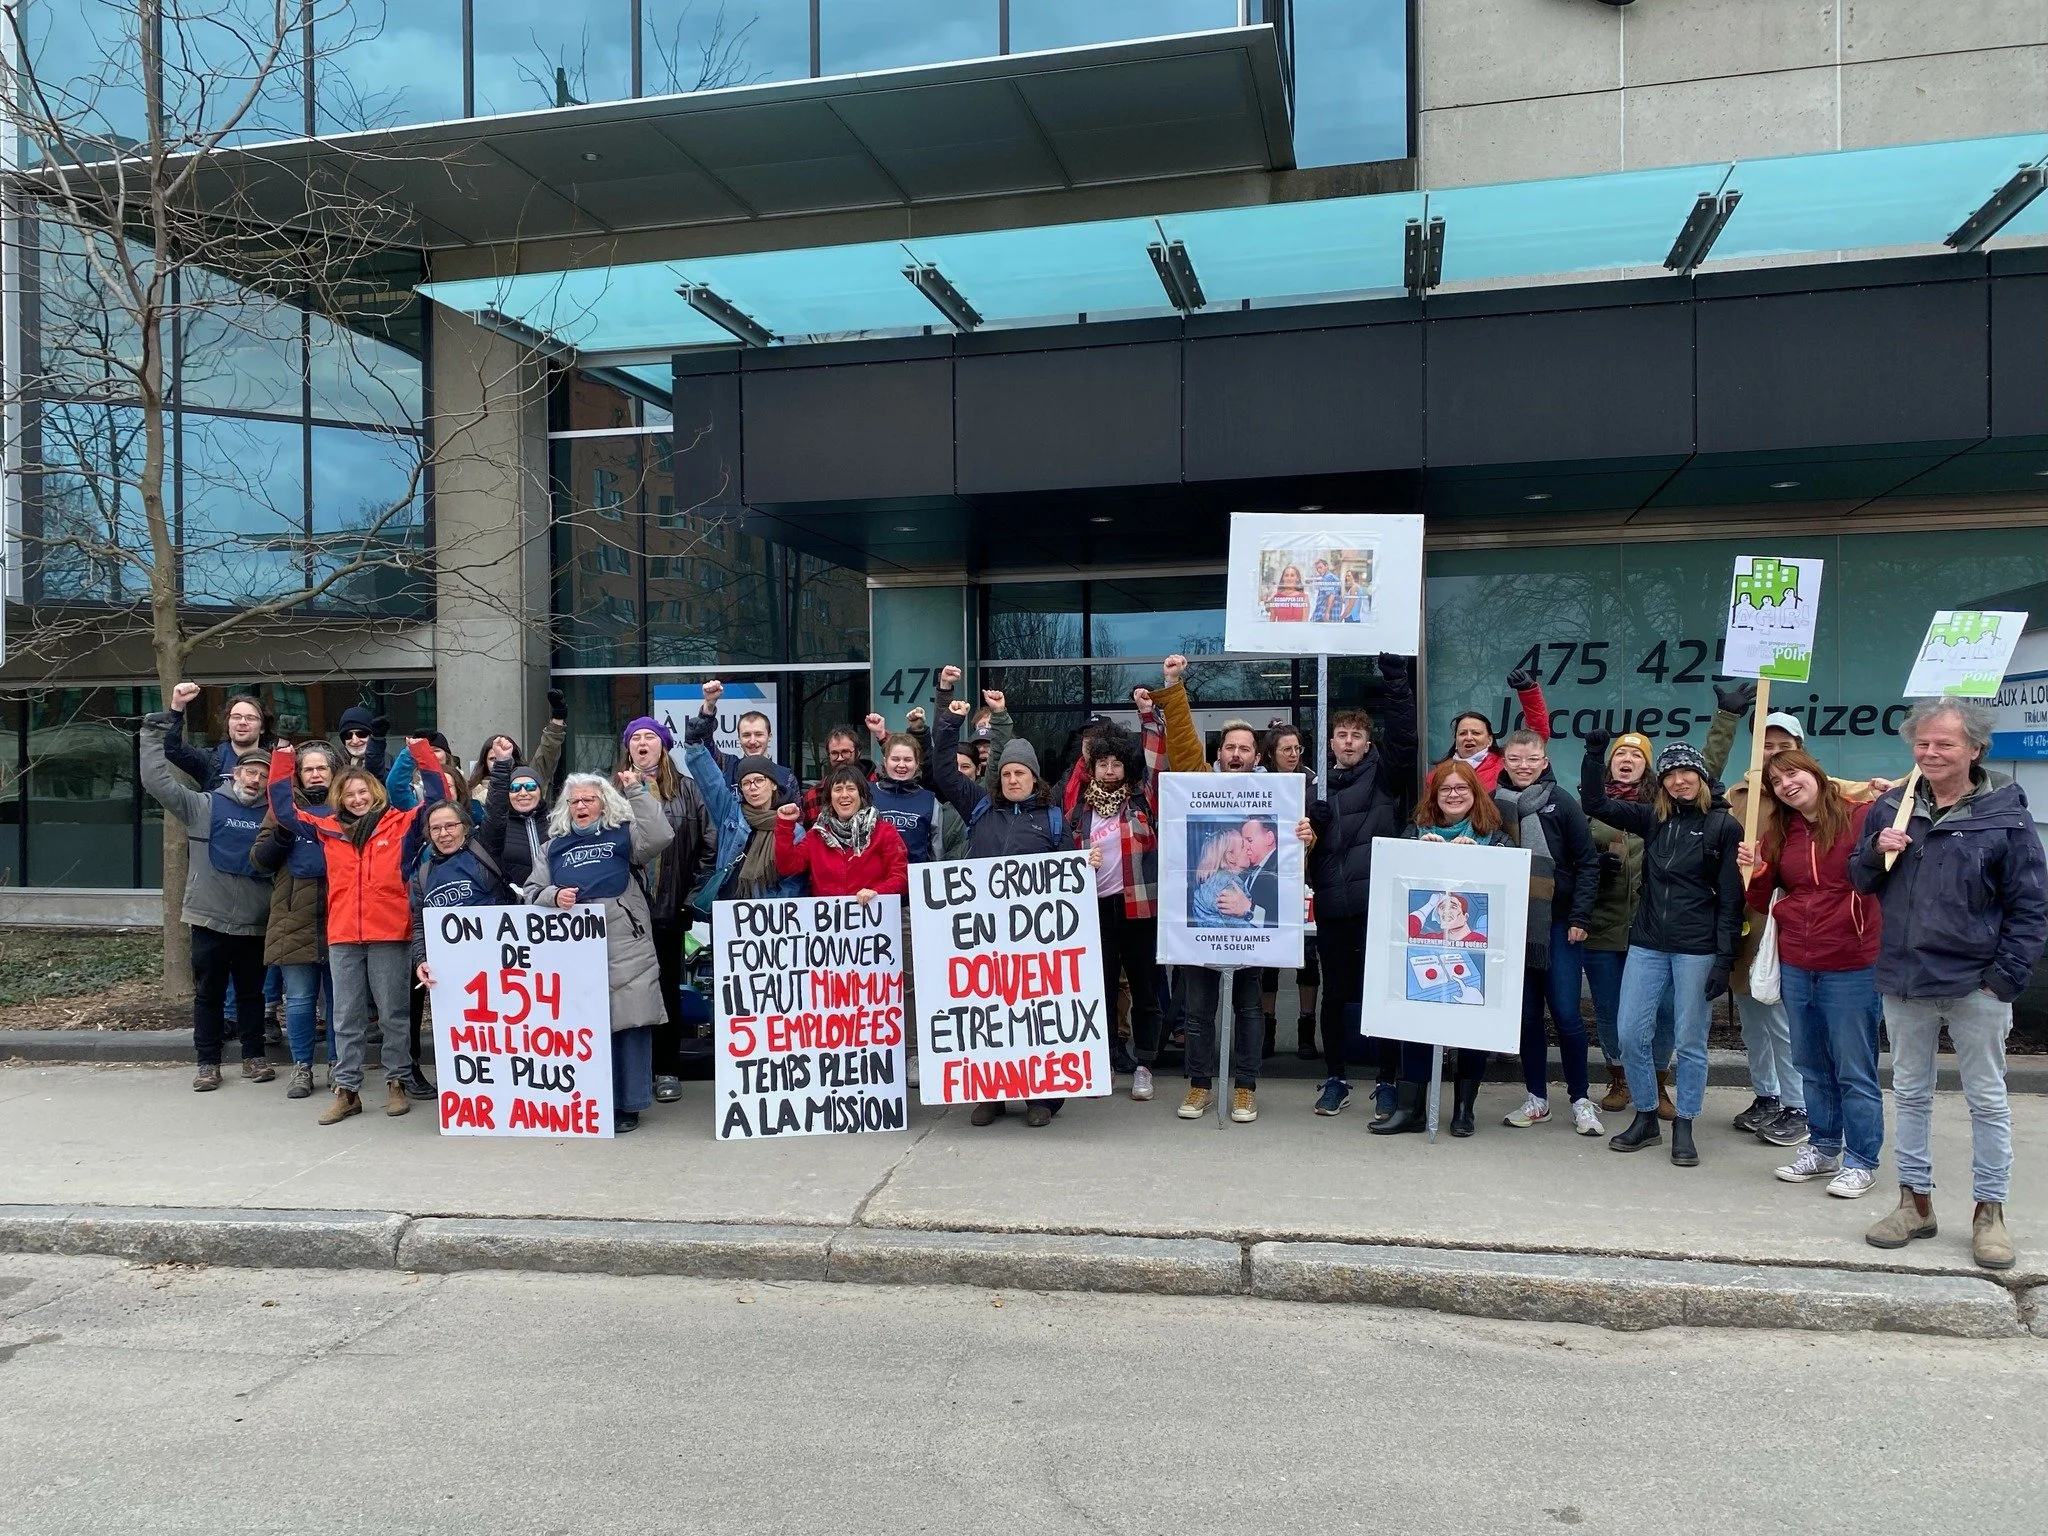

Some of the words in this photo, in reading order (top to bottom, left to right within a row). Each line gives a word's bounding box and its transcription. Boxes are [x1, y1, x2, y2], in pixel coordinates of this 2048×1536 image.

[1514, 641, 1610, 686] 475
[1189, 800, 1273, 809] COMMUNAUTAIRE
[1191, 791, 1234, 800] LEGAULT,
[1236, 791, 1260, 799] AIME
[1262, 791, 1273, 799] LE
[922, 866, 977, 910] LES
[988, 856, 1087, 899] GROUPES
[441, 912, 484, 944] ON
[496, 912, 520, 942] A
[732, 901, 801, 937] POUR
[952, 912, 996, 950] EN
[1009, 899, 1079, 945] DCD
[1195, 934, 1230, 943] COMME
[1231, 934, 1242, 943] TU
[1243, 934, 1271, 943] AIMES
[501, 944, 532, 969] DE
[1210, 943, 1223, 951] TA
[1224, 943, 1255, 951] SOEUR!
[463, 968, 561, 1025] 154
[749, 969, 809, 1014] FAUT
[728, 1016, 758, 1058] 5
[930, 1003, 1003, 1054] ÊTRE
[454, 1054, 495, 1084] DE
[510, 1056, 576, 1093] PLUS
[735, 1053, 811, 1095] TEMPS
[440, 1090, 496, 1130] PAR
[509, 1091, 600, 1134] ANNÉE
[721, 1089, 753, 1139] À
[759, 1097, 801, 1136] LA
